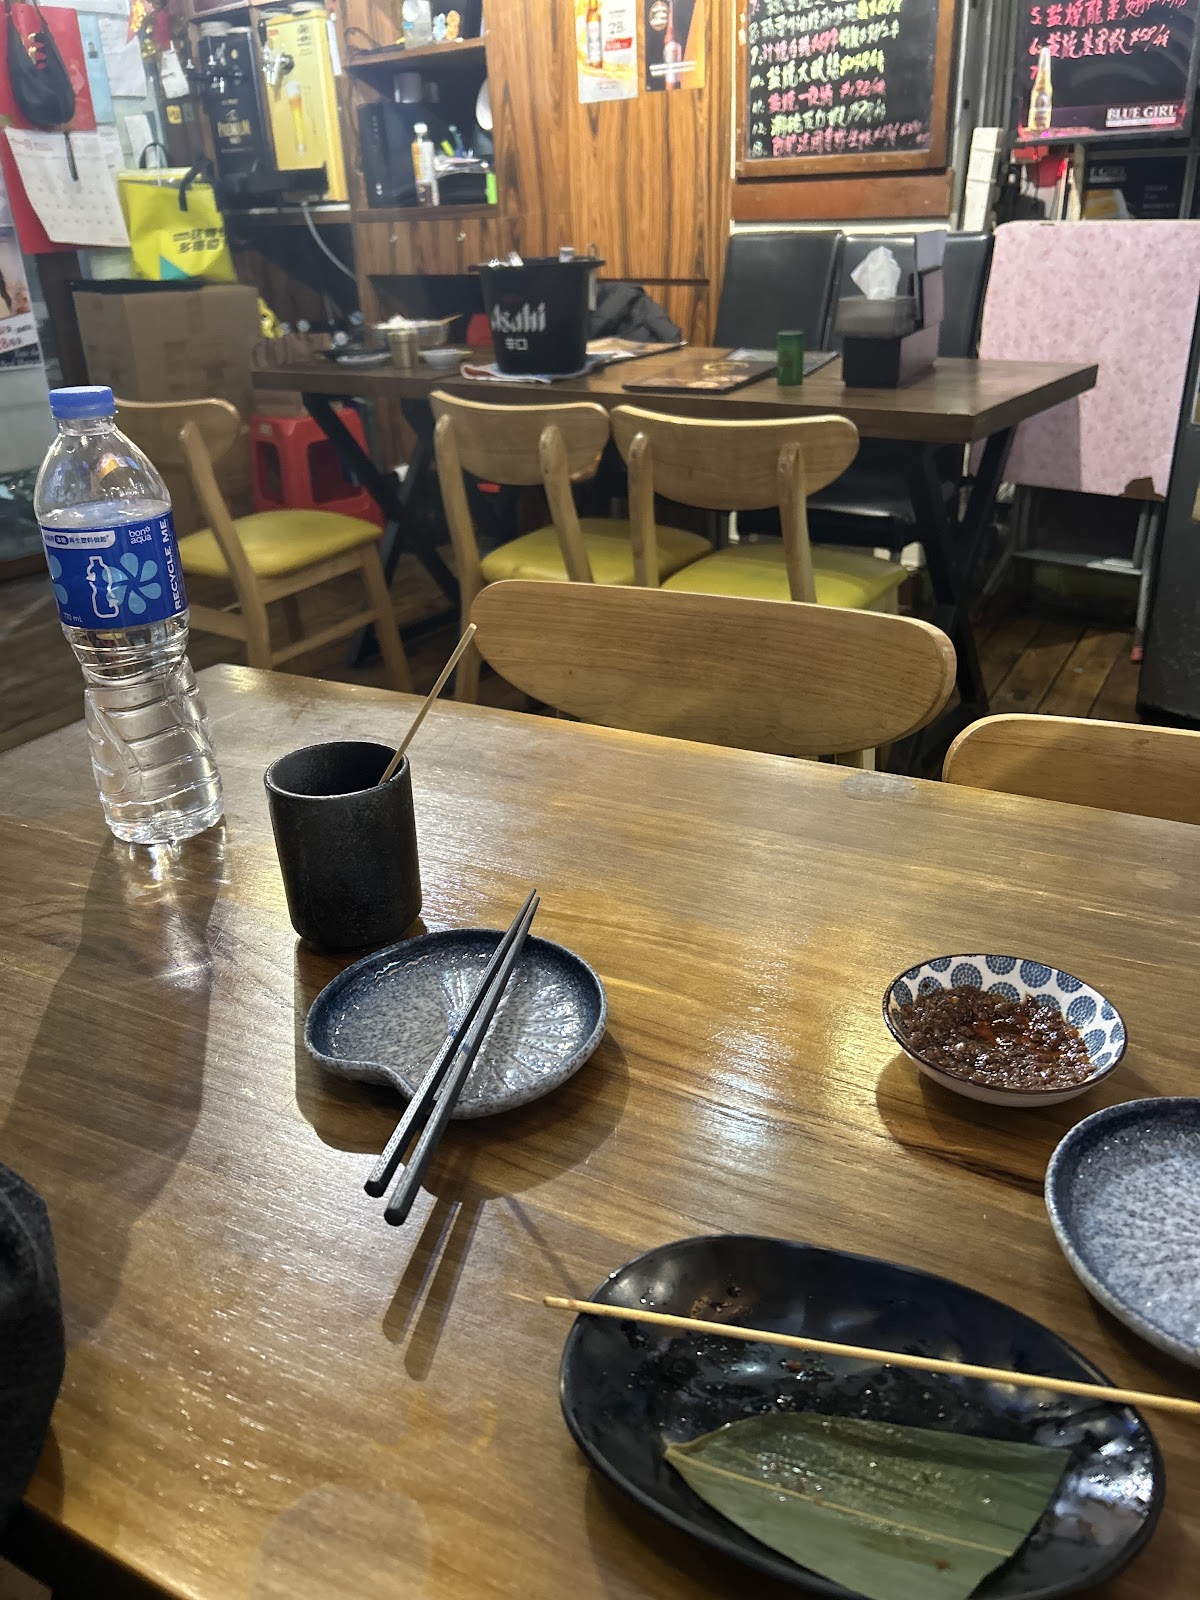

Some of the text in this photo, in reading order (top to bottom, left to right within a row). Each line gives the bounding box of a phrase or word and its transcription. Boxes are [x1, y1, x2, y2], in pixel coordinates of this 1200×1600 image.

[1107, 105, 1176, 120] BLUE GIRL
[130, 534, 153, 545] aqua
[159, 518, 170, 543] ME
[164, 545, 182, 611] RECYCLE
